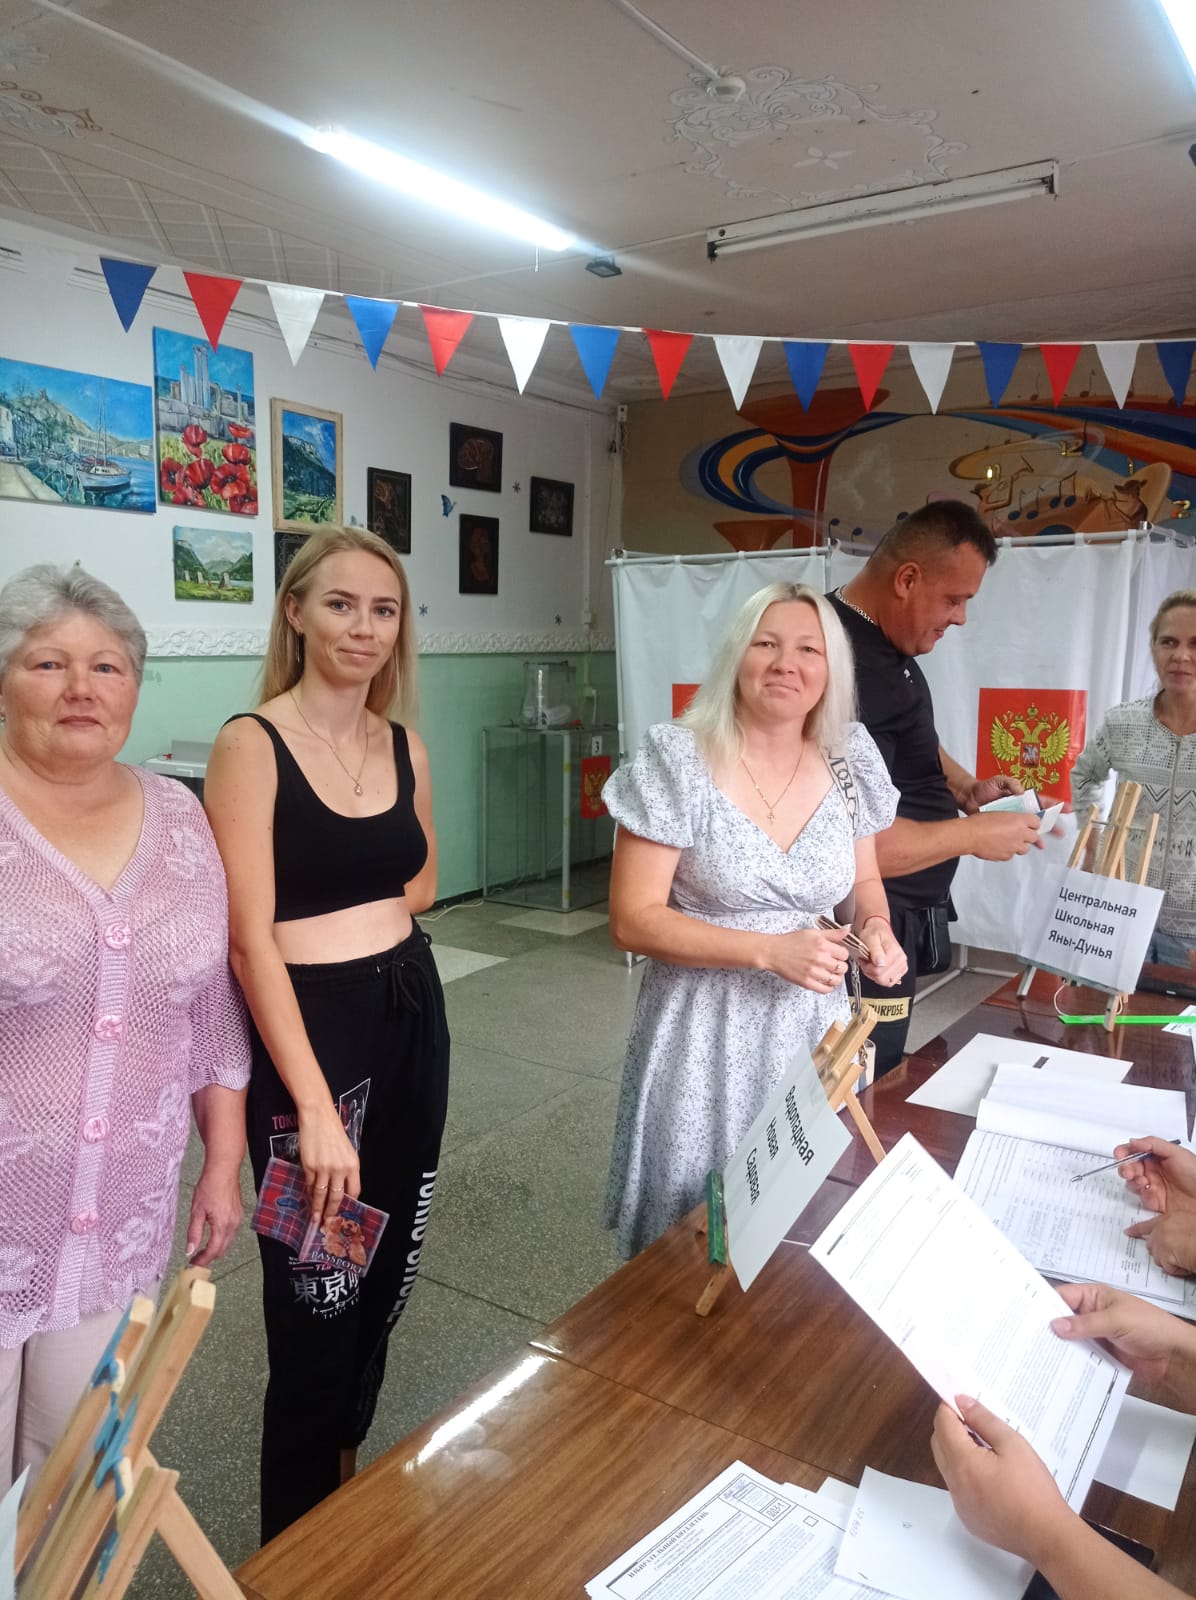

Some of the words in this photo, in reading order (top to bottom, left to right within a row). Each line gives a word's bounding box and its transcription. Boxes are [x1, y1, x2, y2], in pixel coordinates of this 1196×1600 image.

[1059, 886, 1137, 918] Центральная
[1054, 908, 1115, 936] Школьная
[1048, 930, 1113, 960] Яны-Дунья
[766, 1116, 779, 1160] Новая
[785, 1085, 815, 1167] Водопадная
[746, 1148, 760, 1206] Садовая
